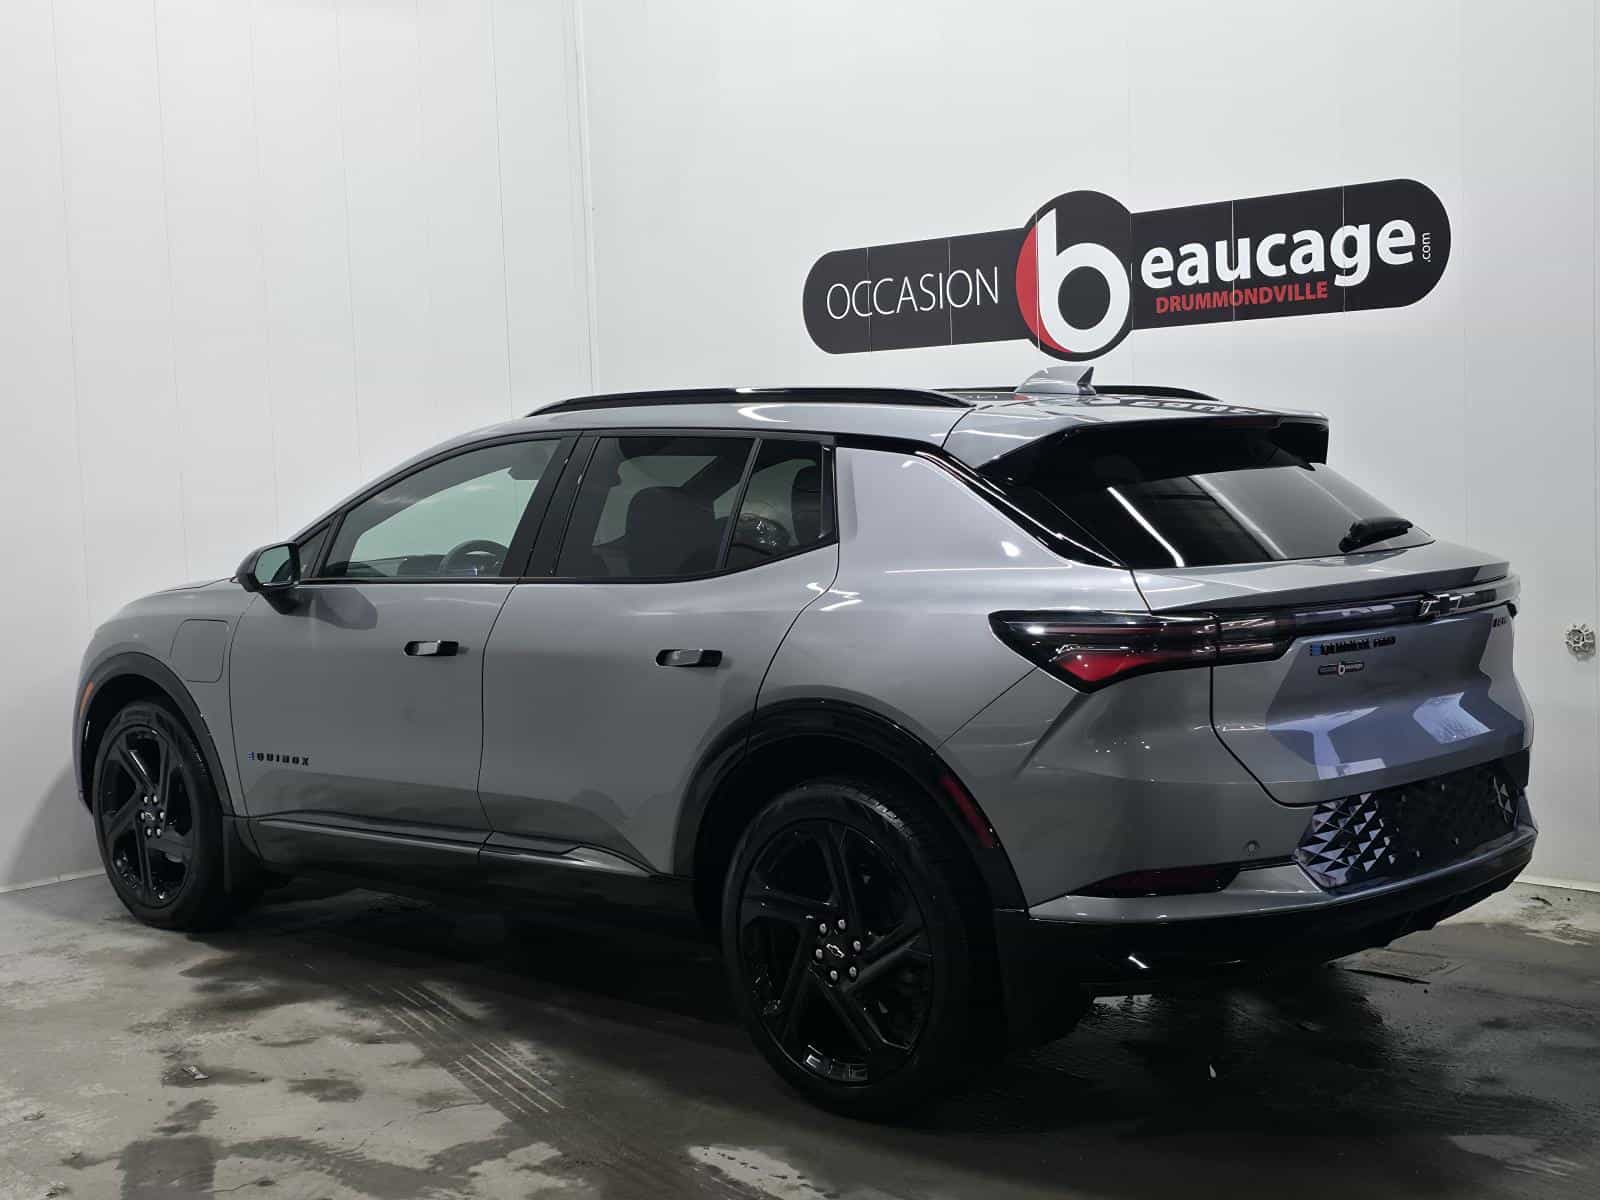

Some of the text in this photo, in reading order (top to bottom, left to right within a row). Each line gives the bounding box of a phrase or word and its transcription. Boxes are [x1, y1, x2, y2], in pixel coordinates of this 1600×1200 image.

[1422, 232, 1431, 263] .com
[826, 265, 999, 320] OCCASION
[1155, 281, 1328, 314] DRUMMONDVILLE
